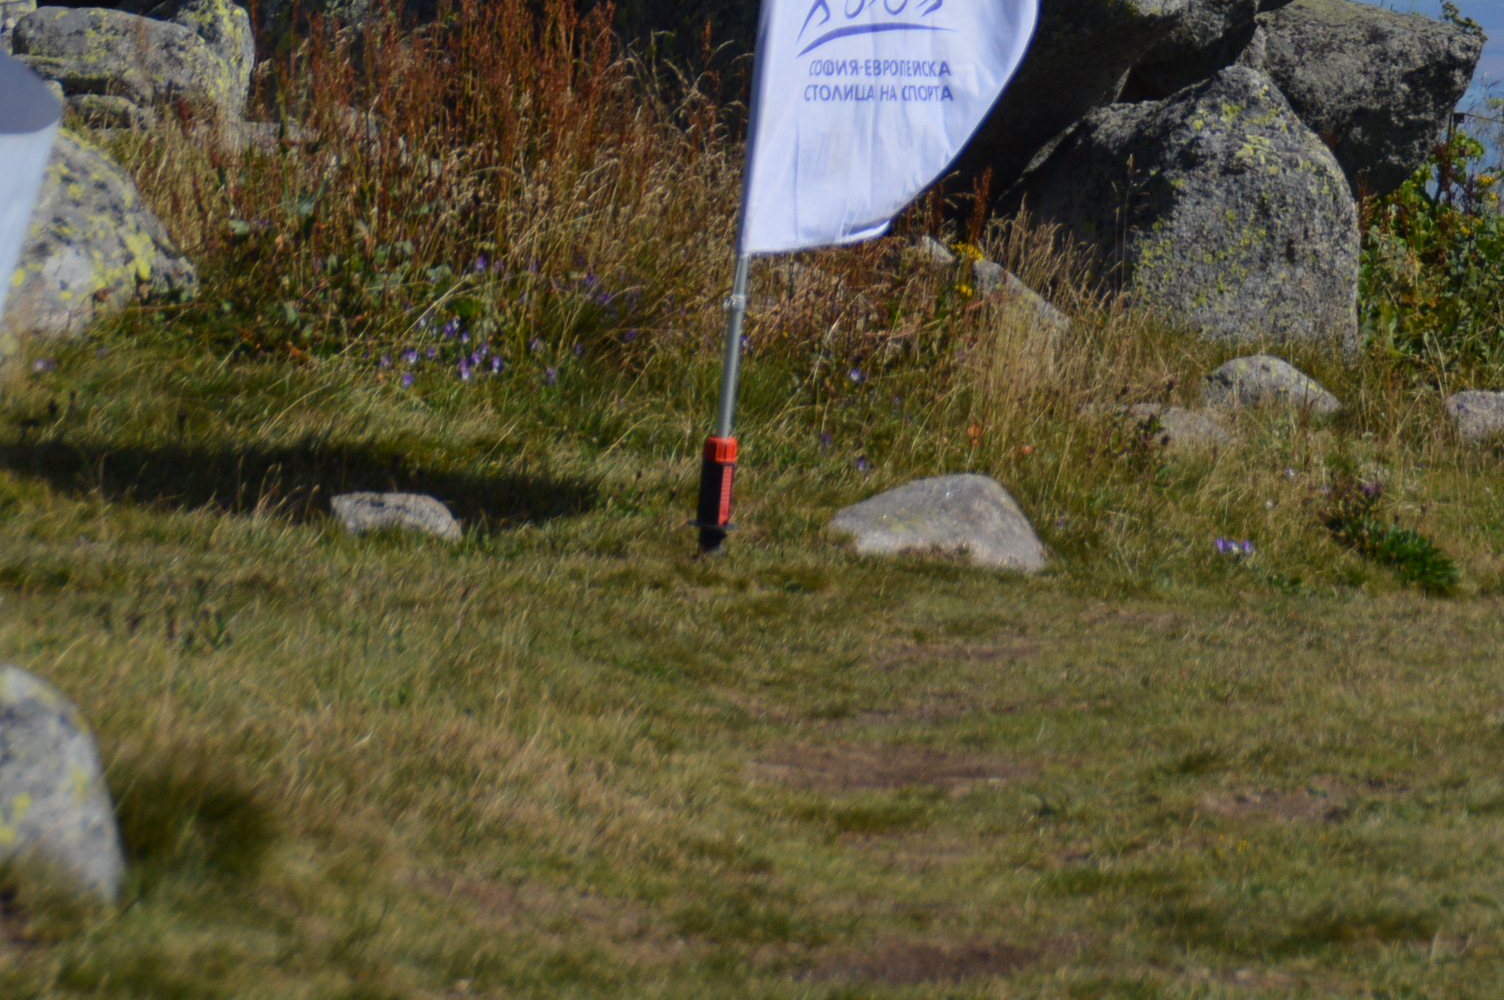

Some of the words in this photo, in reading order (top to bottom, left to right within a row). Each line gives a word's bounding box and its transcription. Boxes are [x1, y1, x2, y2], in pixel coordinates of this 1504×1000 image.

[804, 84, 874, 102] СТОЛИЦА
[880, 84, 897, 101] НА
[902, 84, 954, 102] СПОРТА
